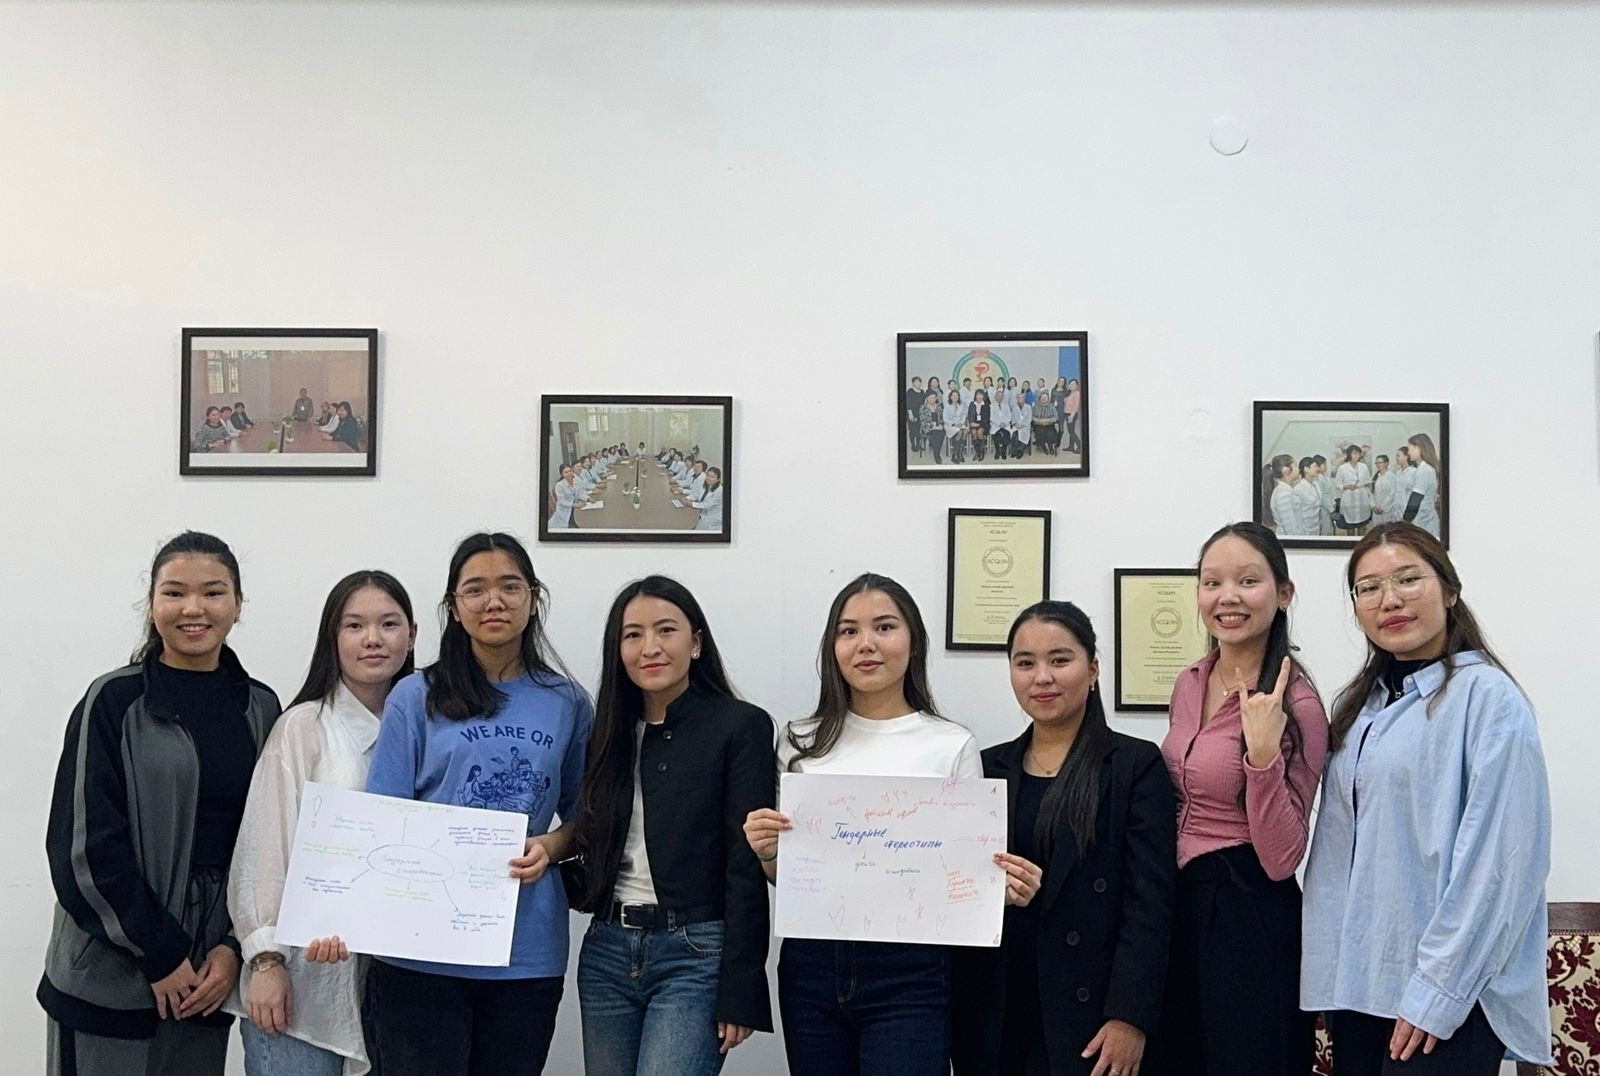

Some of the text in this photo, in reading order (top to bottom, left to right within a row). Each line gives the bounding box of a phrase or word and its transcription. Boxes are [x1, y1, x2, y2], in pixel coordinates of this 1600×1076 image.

[460, 725, 554, 749] WE ARE QR
[831, 822, 888, 845] Гендерные
[883, 840, 943, 854] стереотипы
